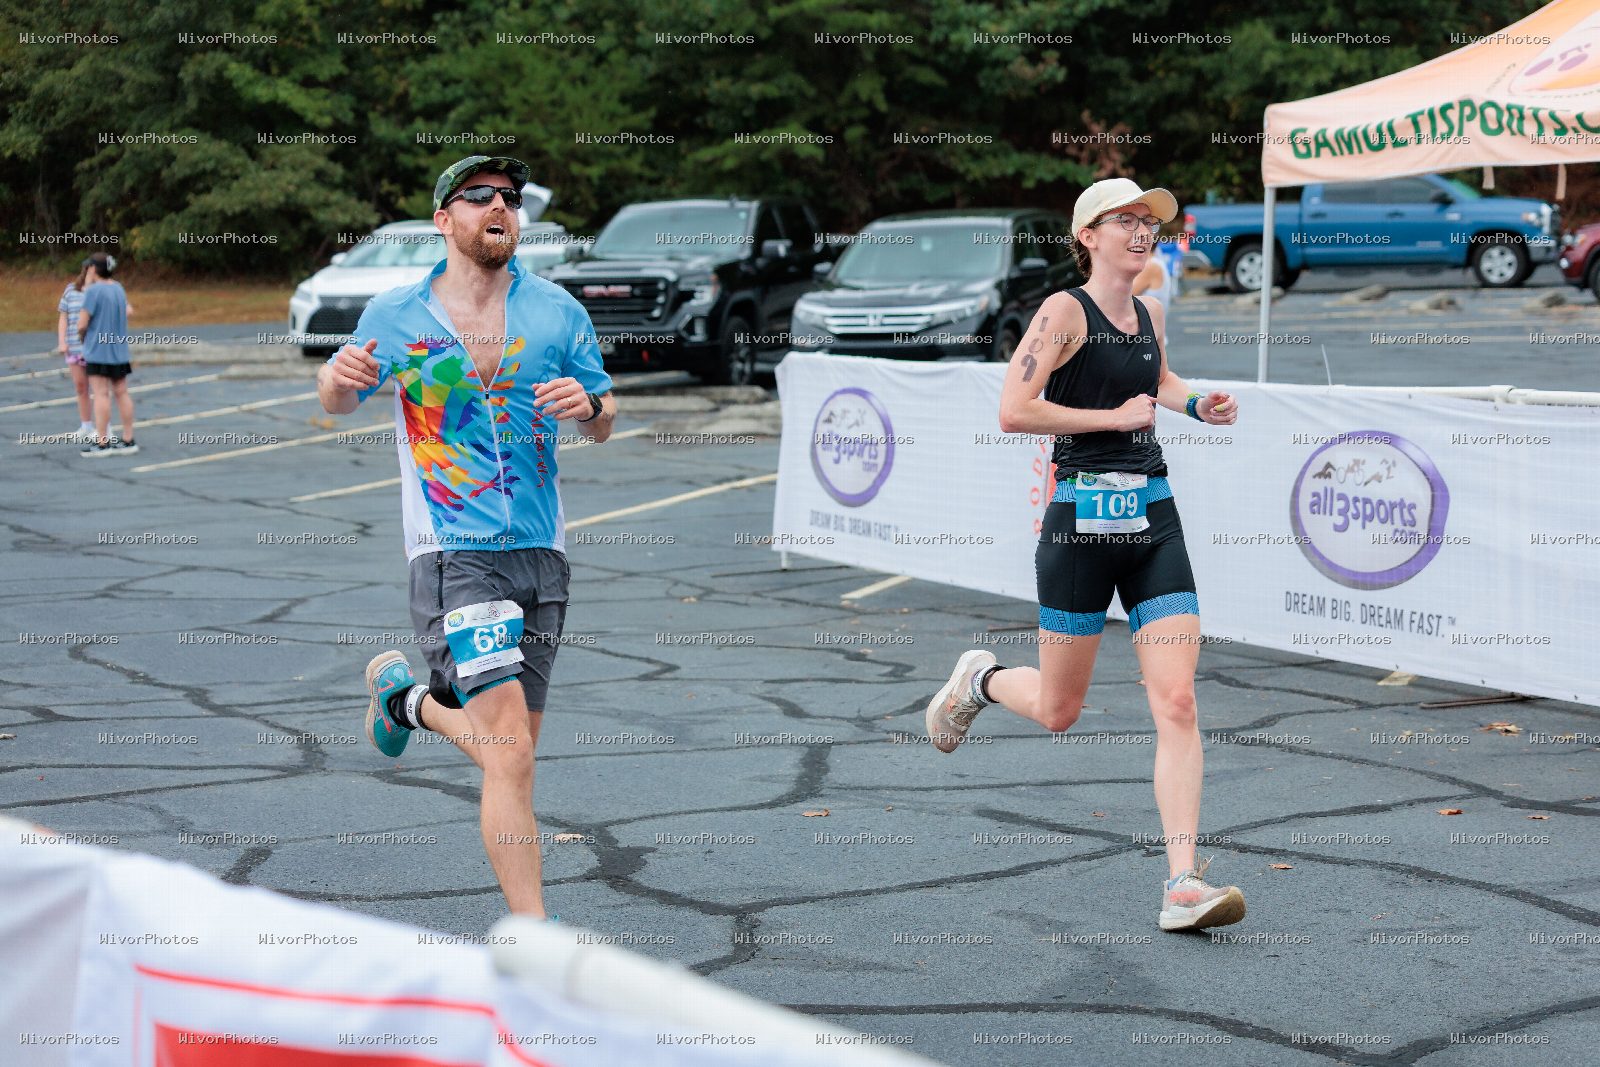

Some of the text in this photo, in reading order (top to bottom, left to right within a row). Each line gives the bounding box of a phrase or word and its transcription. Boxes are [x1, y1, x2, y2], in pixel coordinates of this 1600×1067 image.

[1091, 492, 1138, 518] 109
[1309, 486, 1417, 532] all3sports
[1285, 591, 1326, 617] DREAM
[1331, 598, 1355, 623] BIG.
[1360, 603, 1404, 631] DREAM
[473, 623, 508, 653] 68
